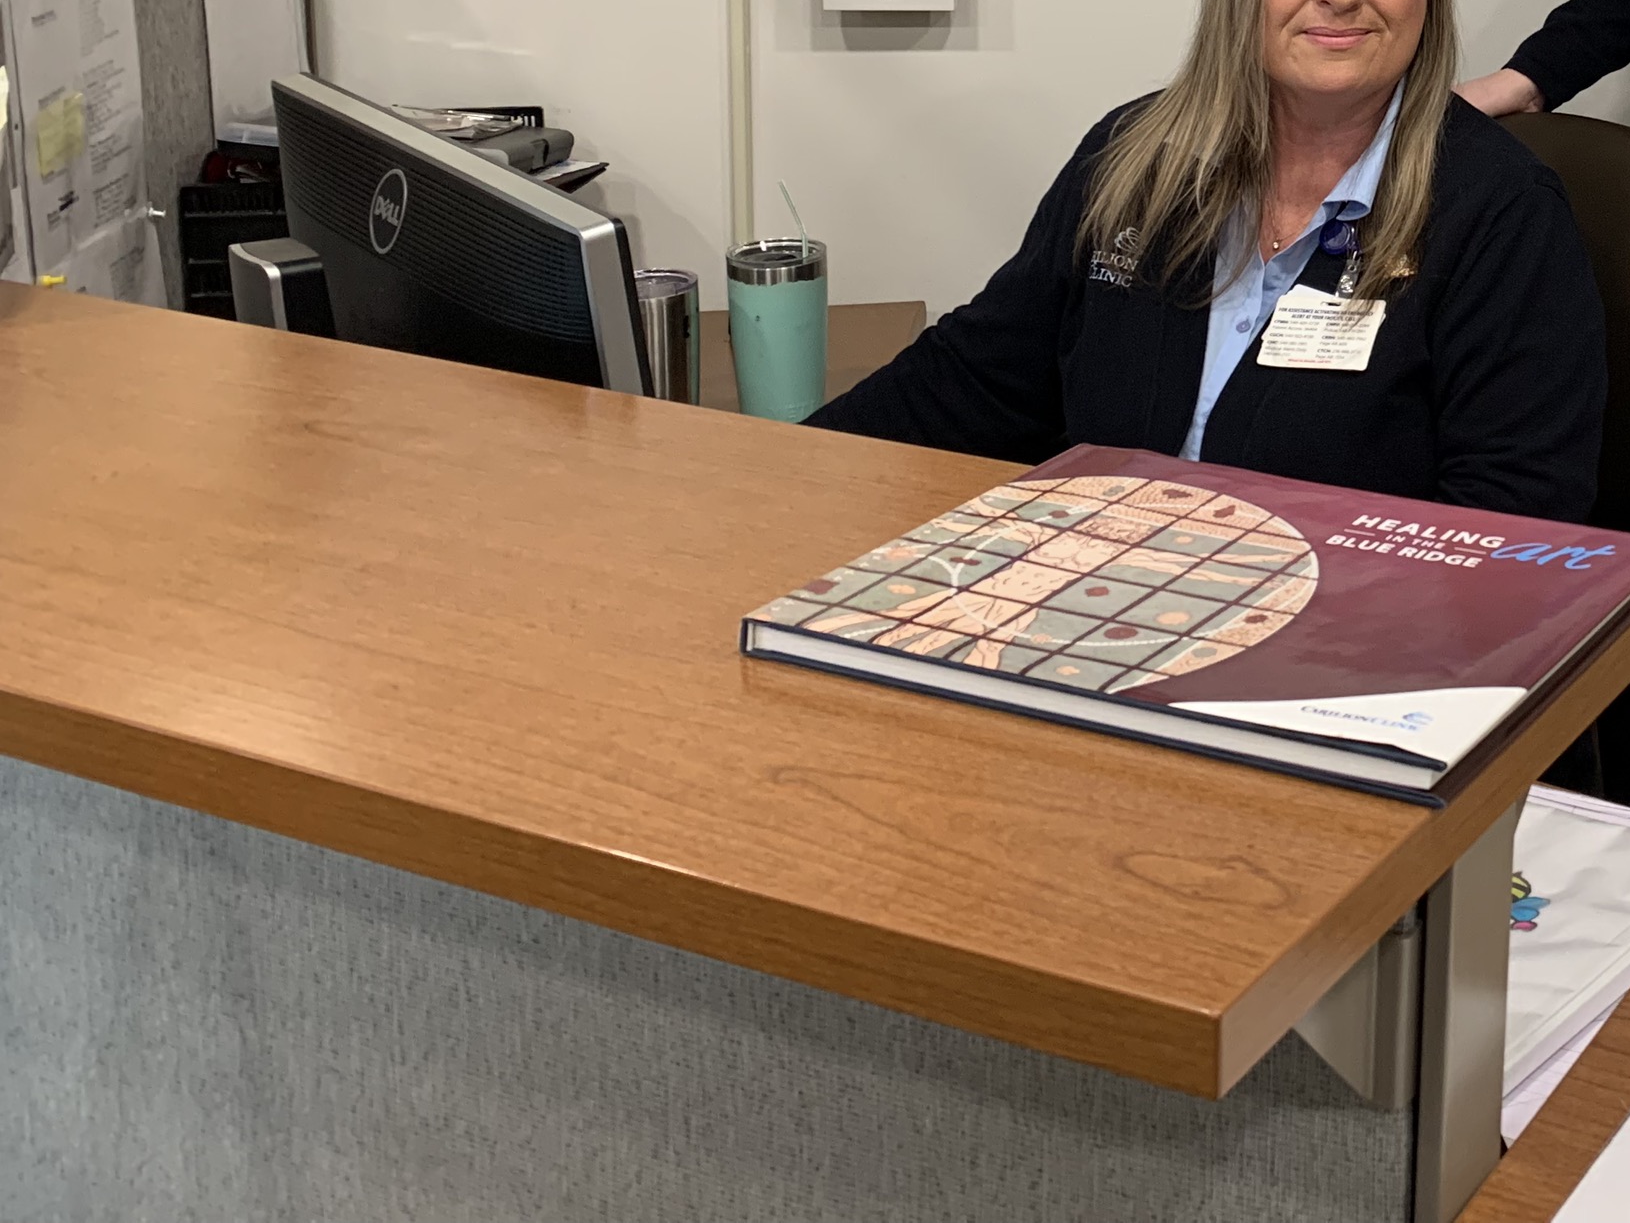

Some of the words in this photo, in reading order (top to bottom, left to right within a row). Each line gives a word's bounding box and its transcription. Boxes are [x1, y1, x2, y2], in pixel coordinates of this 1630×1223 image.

[374, 195, 400, 227] DELL
[1089, 267, 1133, 288] LINIC
[1352, 514, 1507, 549] HEALING
[1385, 534, 1406, 543] IN
[1412, 538, 1446, 550] THE
[1325, 534, 1396, 555] BLUE
[1397, 545, 1483, 568] RIDGE
[1490, 543, 1616, 570] art
